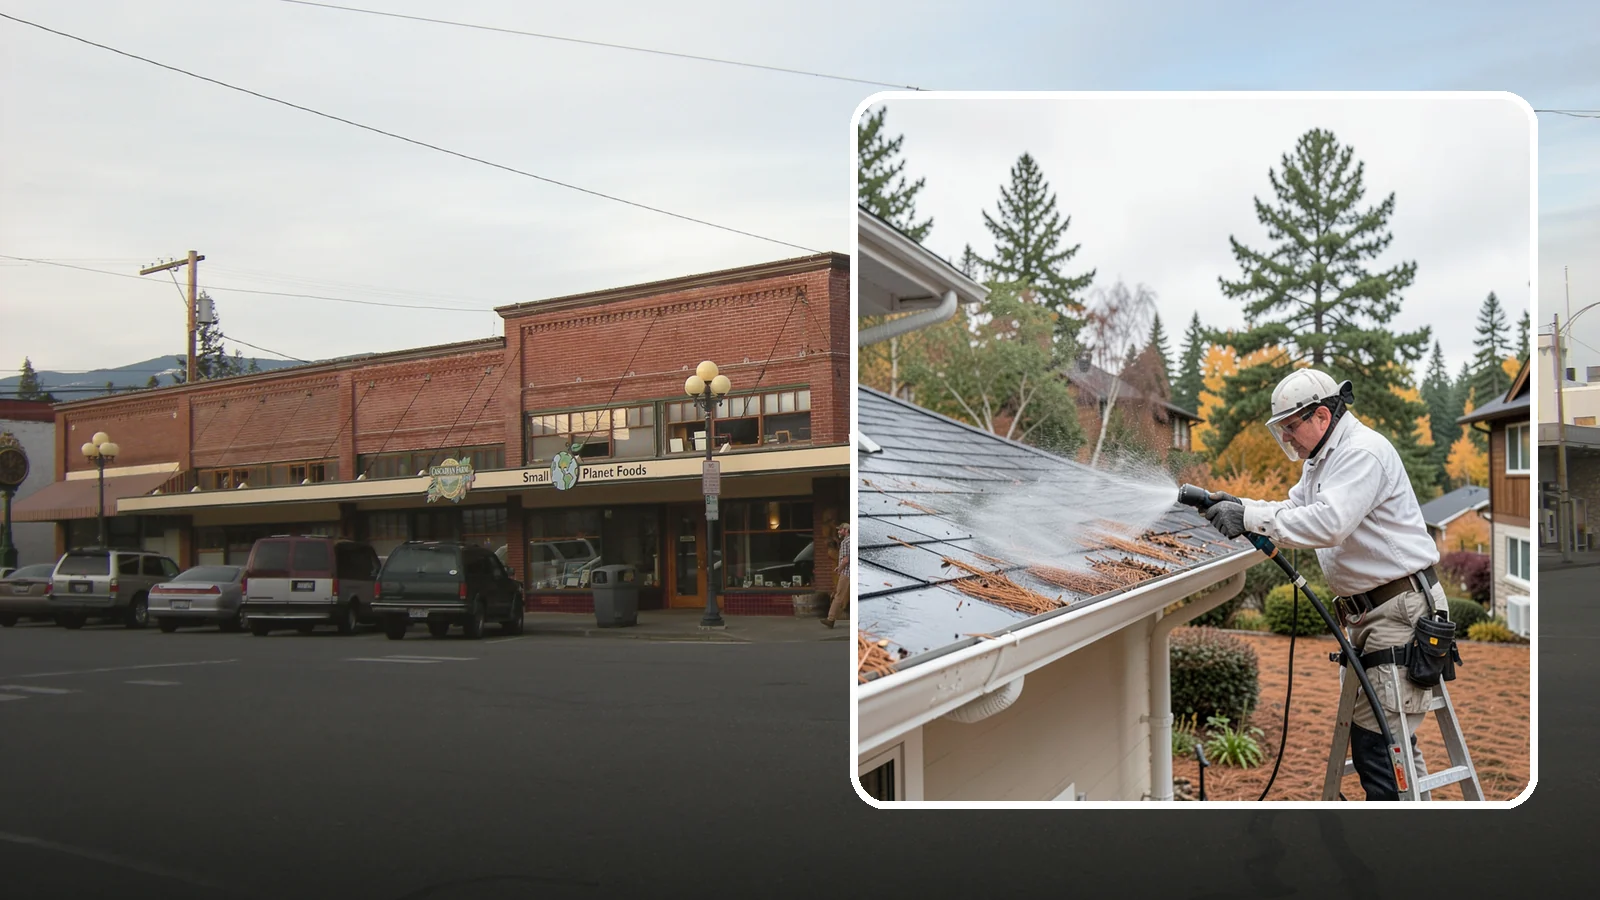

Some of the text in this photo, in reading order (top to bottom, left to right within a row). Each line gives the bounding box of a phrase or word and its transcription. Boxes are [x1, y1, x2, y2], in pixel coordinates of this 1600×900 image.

[523, 464, 647, 483] Small Planet Foods
